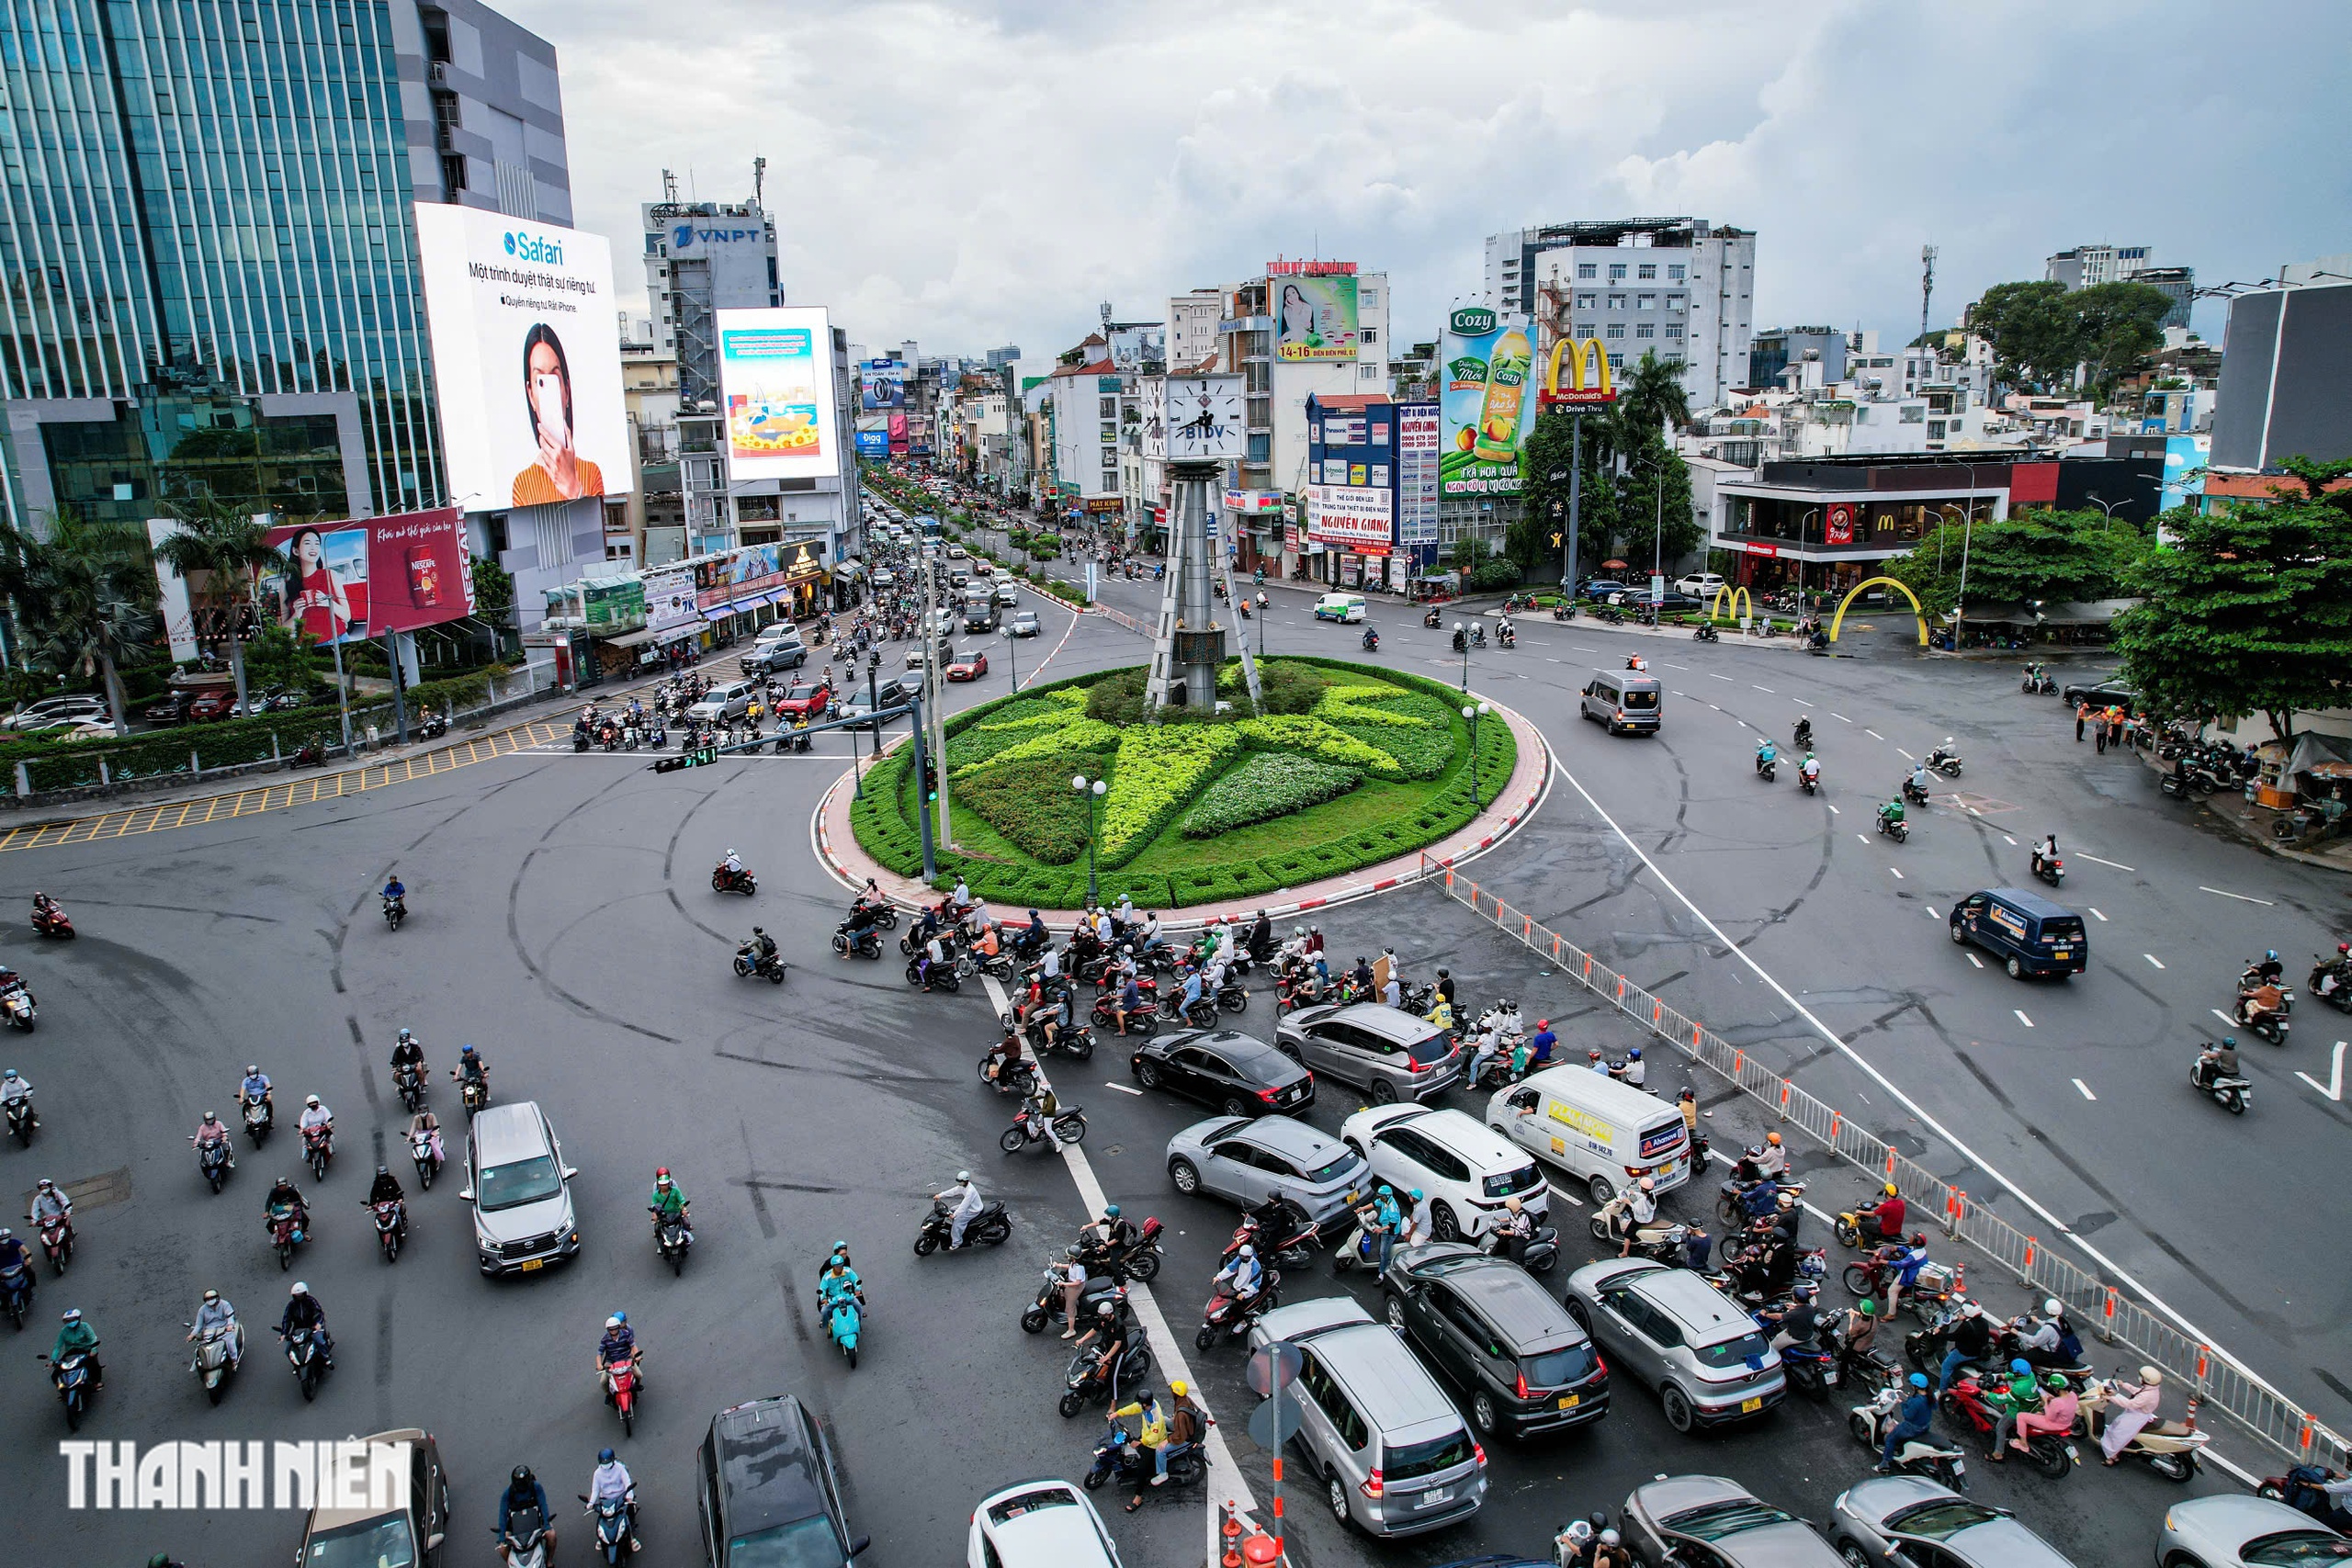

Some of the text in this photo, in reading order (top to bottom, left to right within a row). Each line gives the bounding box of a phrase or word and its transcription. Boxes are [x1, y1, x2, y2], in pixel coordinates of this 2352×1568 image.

[697, 230, 760, 243] VNPT
[517, 231, 563, 265] Safari
[469, 261, 488, 283] Một
[489, 265, 511, 283] trình
[512, 268, 537, 289] duyệt
[537, 272, 555, 291] thật
[555, 276, 566, 293] sự
[566, 276, 585, 296] riêng
[1454, 312, 1492, 331] Cozy
[1280, 346, 1310, 357] 14-16
[1458, 367, 1485, 381] Mới
[1495, 369, 1521, 384] Cozy
[1556, 392, 1602, 400] McDonald's
[1566, 405, 1586, 413] Drive
[1185, 425, 1225, 439] BIDV
[1422, 421, 1438, 432] GIANG
[1325, 467, 1346, 477] Schneider
[1461, 461, 1518, 478] TRÀ HOA QUẢ
[1446, 481, 1464, 492] NGON
[1361, 518, 1389, 533] GIANG
[684, 574, 695, 586] 7K
[682, 599, 695, 616] 7K
[698, 748, 716, 762] 41
[1441, 1009, 1451, 1018] be
[1653, 1133, 1677, 1147] Ahamove
